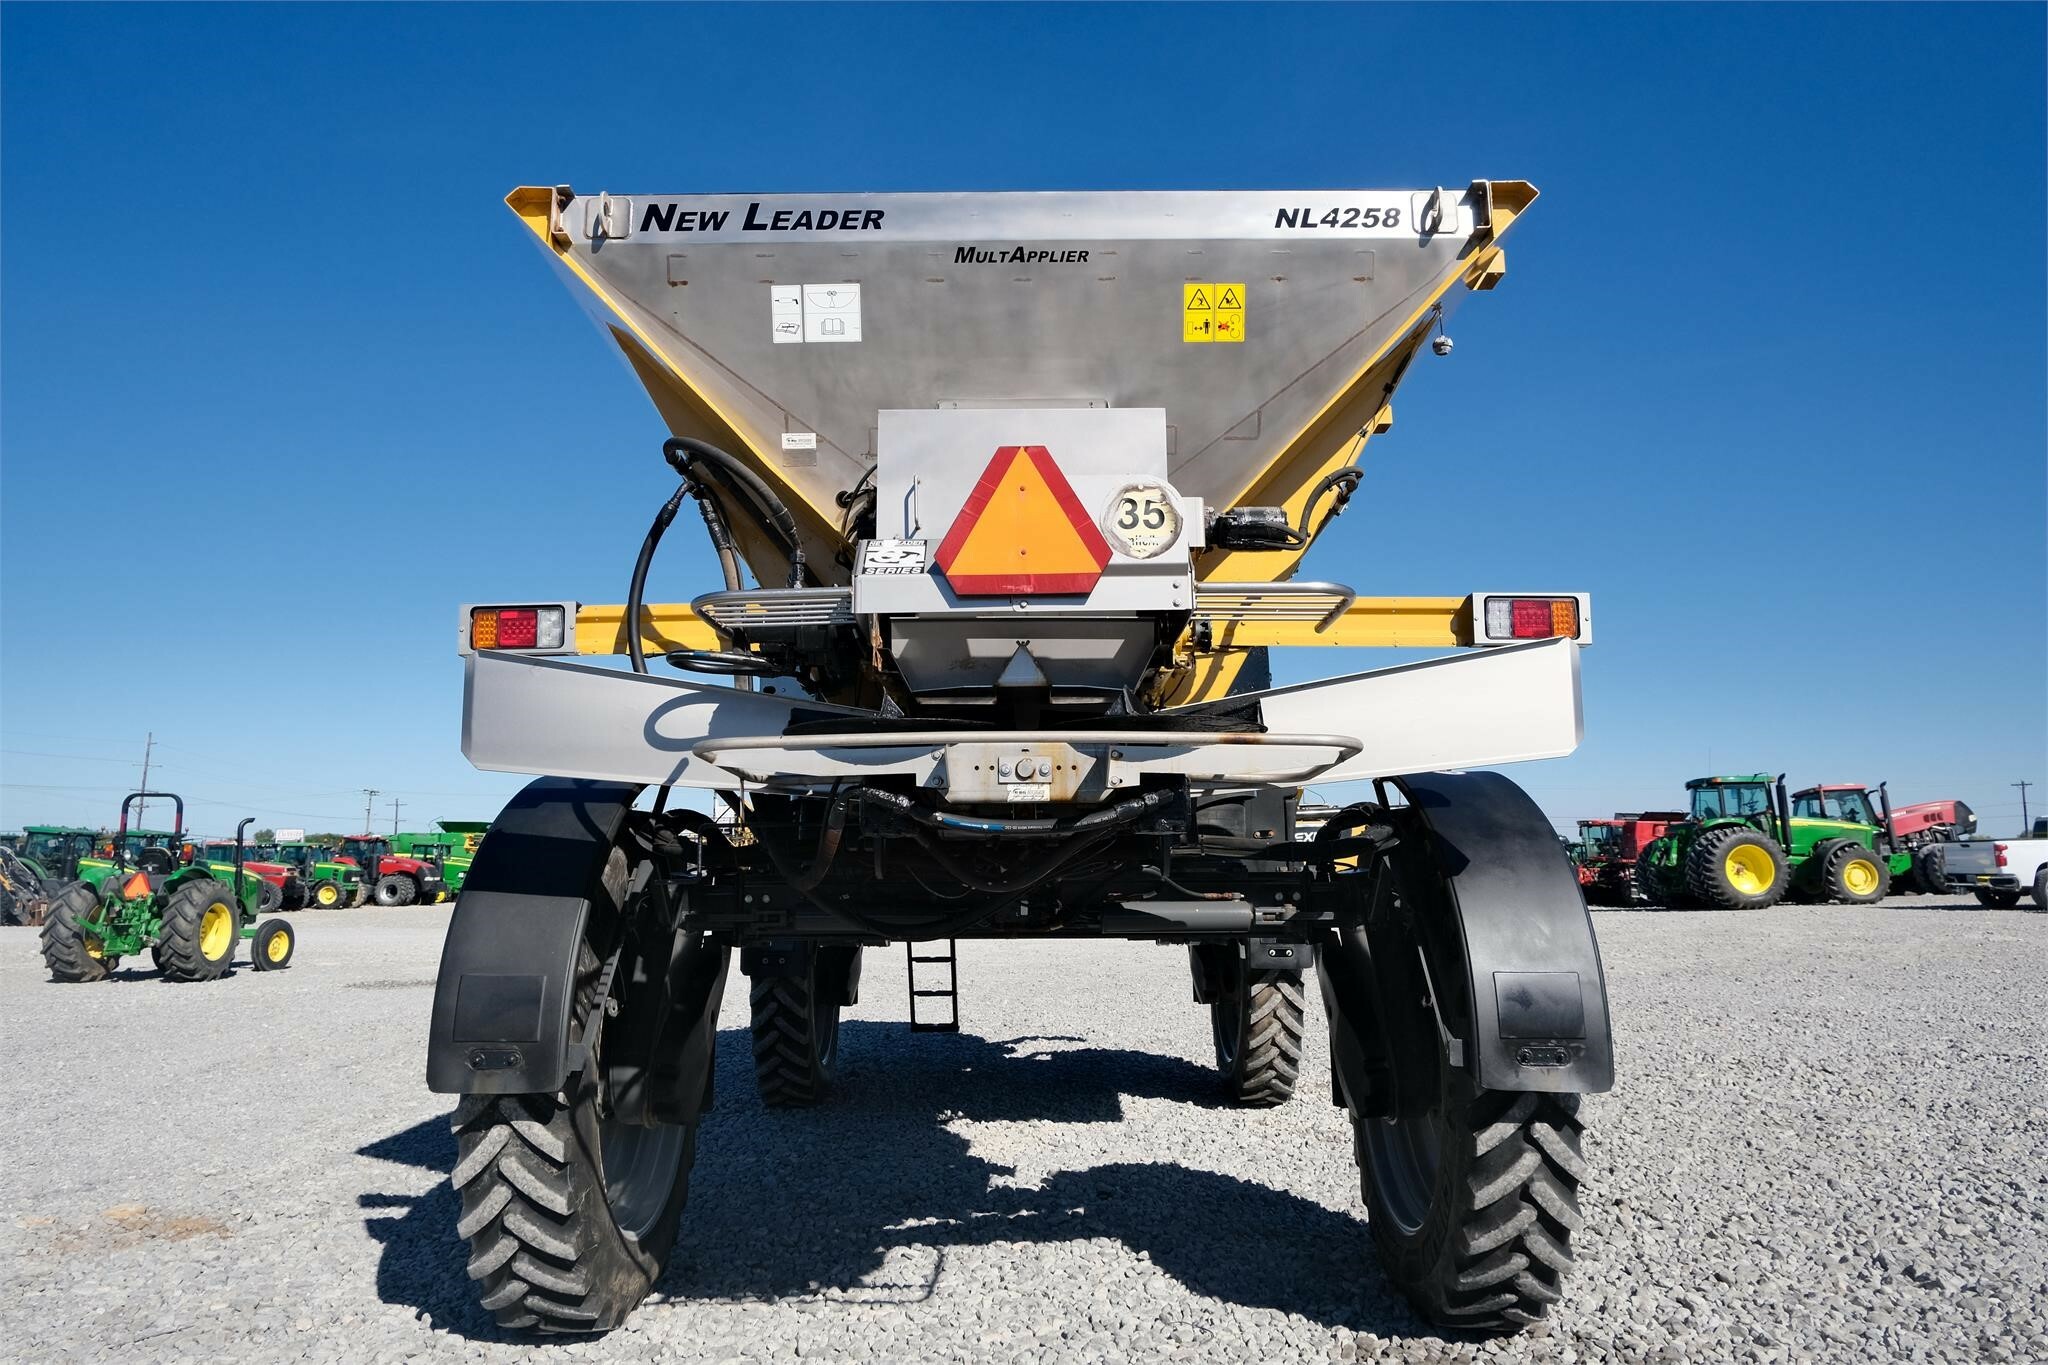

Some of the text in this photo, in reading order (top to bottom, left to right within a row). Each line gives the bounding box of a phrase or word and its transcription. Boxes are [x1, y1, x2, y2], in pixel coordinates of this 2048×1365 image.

[640, 203, 885, 231] NEW LEADER
[1275, 208, 1401, 229] NL4258
[1118, 498, 1166, 530] 35
